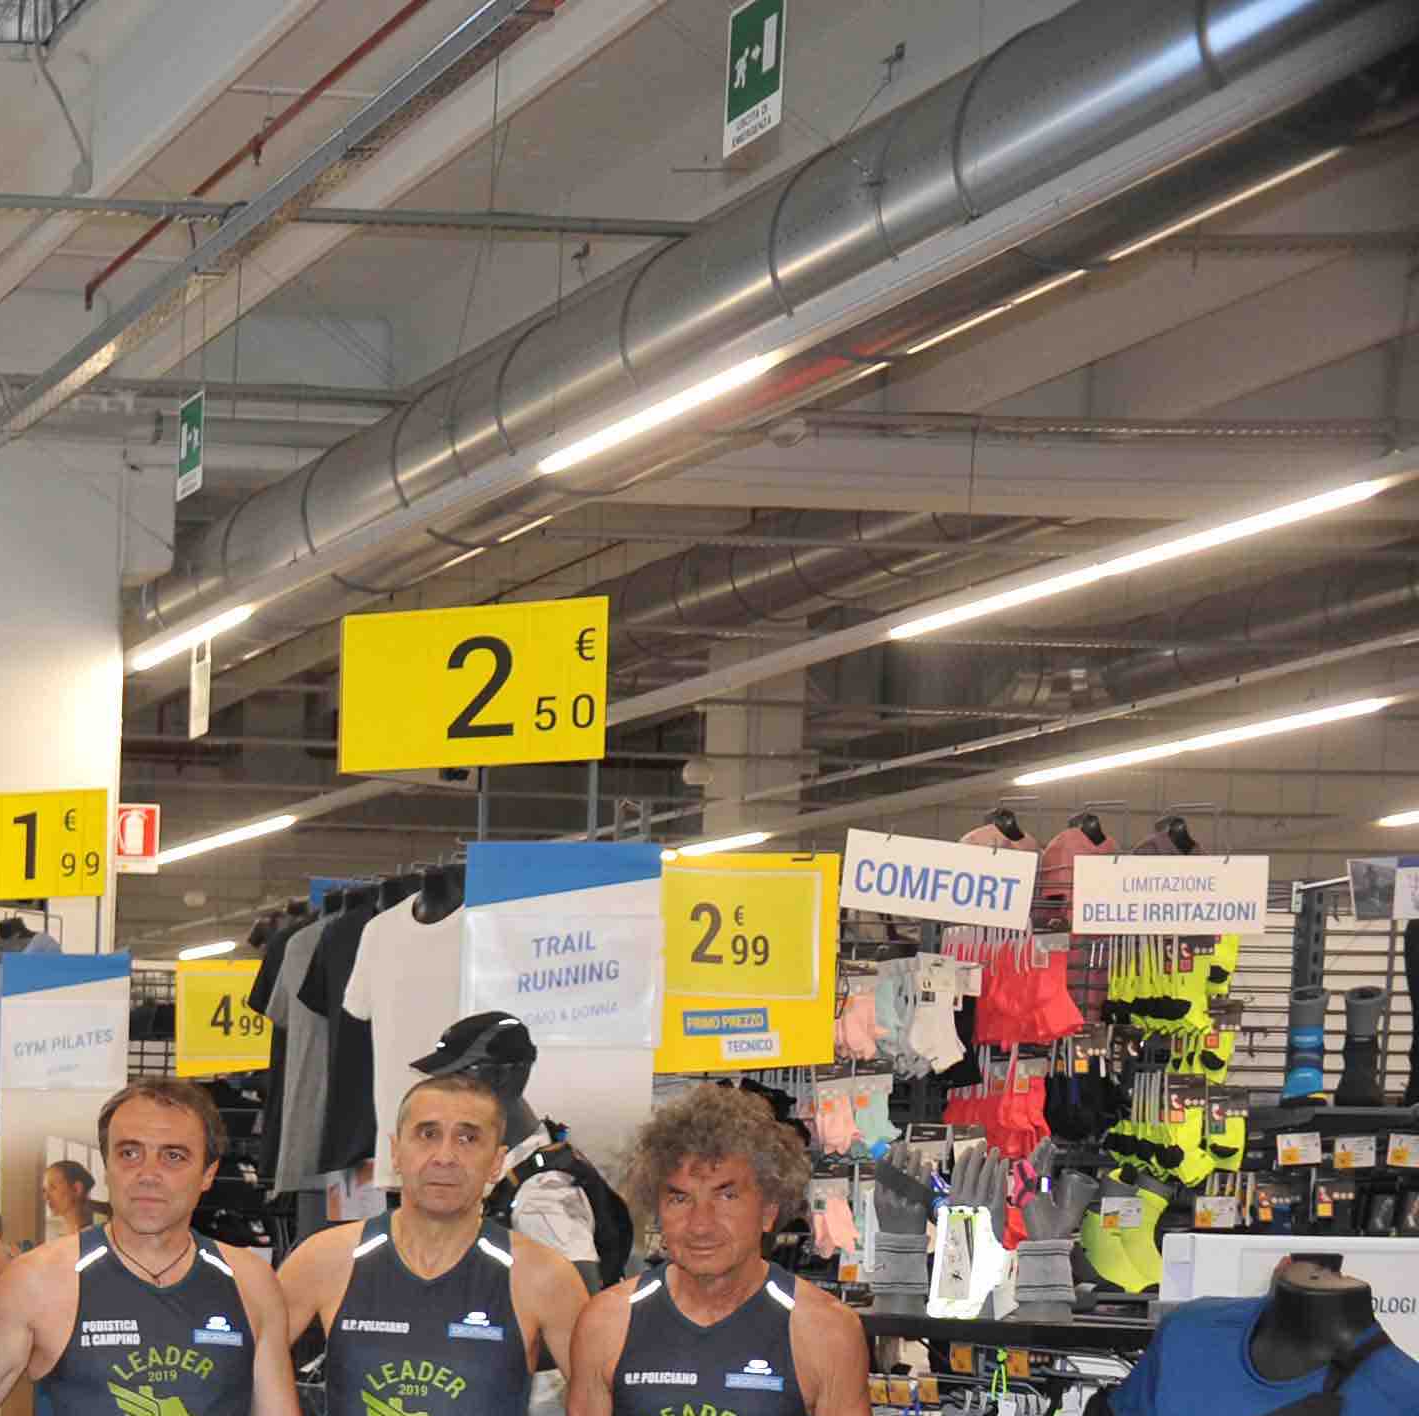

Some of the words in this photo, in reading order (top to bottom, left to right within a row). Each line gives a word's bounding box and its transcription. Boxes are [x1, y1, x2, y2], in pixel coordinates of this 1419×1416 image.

[575, 627, 596, 660] €
[446, 635, 514, 740] 2
[534, 693, 595, 731] 50
[61, 851, 100, 876] 99
[855, 859, 1020, 912] COMFORT
[1122, 876, 1215, 893] LIMITAZIONE
[1082, 903, 1137, 922] DELLE
[1143, 902, 1256, 922] IRRITAZIONI
[532, 930, 597, 959] TRAIL
[690, 902, 723, 965] 2
[731, 934, 770, 966] 99
[517, 960, 620, 993] RUNNING
[211, 993, 234, 1036] 4
[238, 1014, 264, 1036] 99
[14, 1038, 48, 1058] GYM
[51, 1029, 113, 1051] PILATES
[726, 1038, 773, 1053] TECNICO
[82, 1319, 138, 1333] PODISTICA
[93, 1333, 141, 1347] CAMPINO
[355, 1320, 410, 1334] POLICIANO
[113, 1345, 215, 1380] LEADER
[147, 1370, 177, 1383] 2019
[366, 1359, 467, 1399] LEADER
[397, 1383, 428, 1397] 2019
[640, 1372, 697, 1386] POLICIANO
